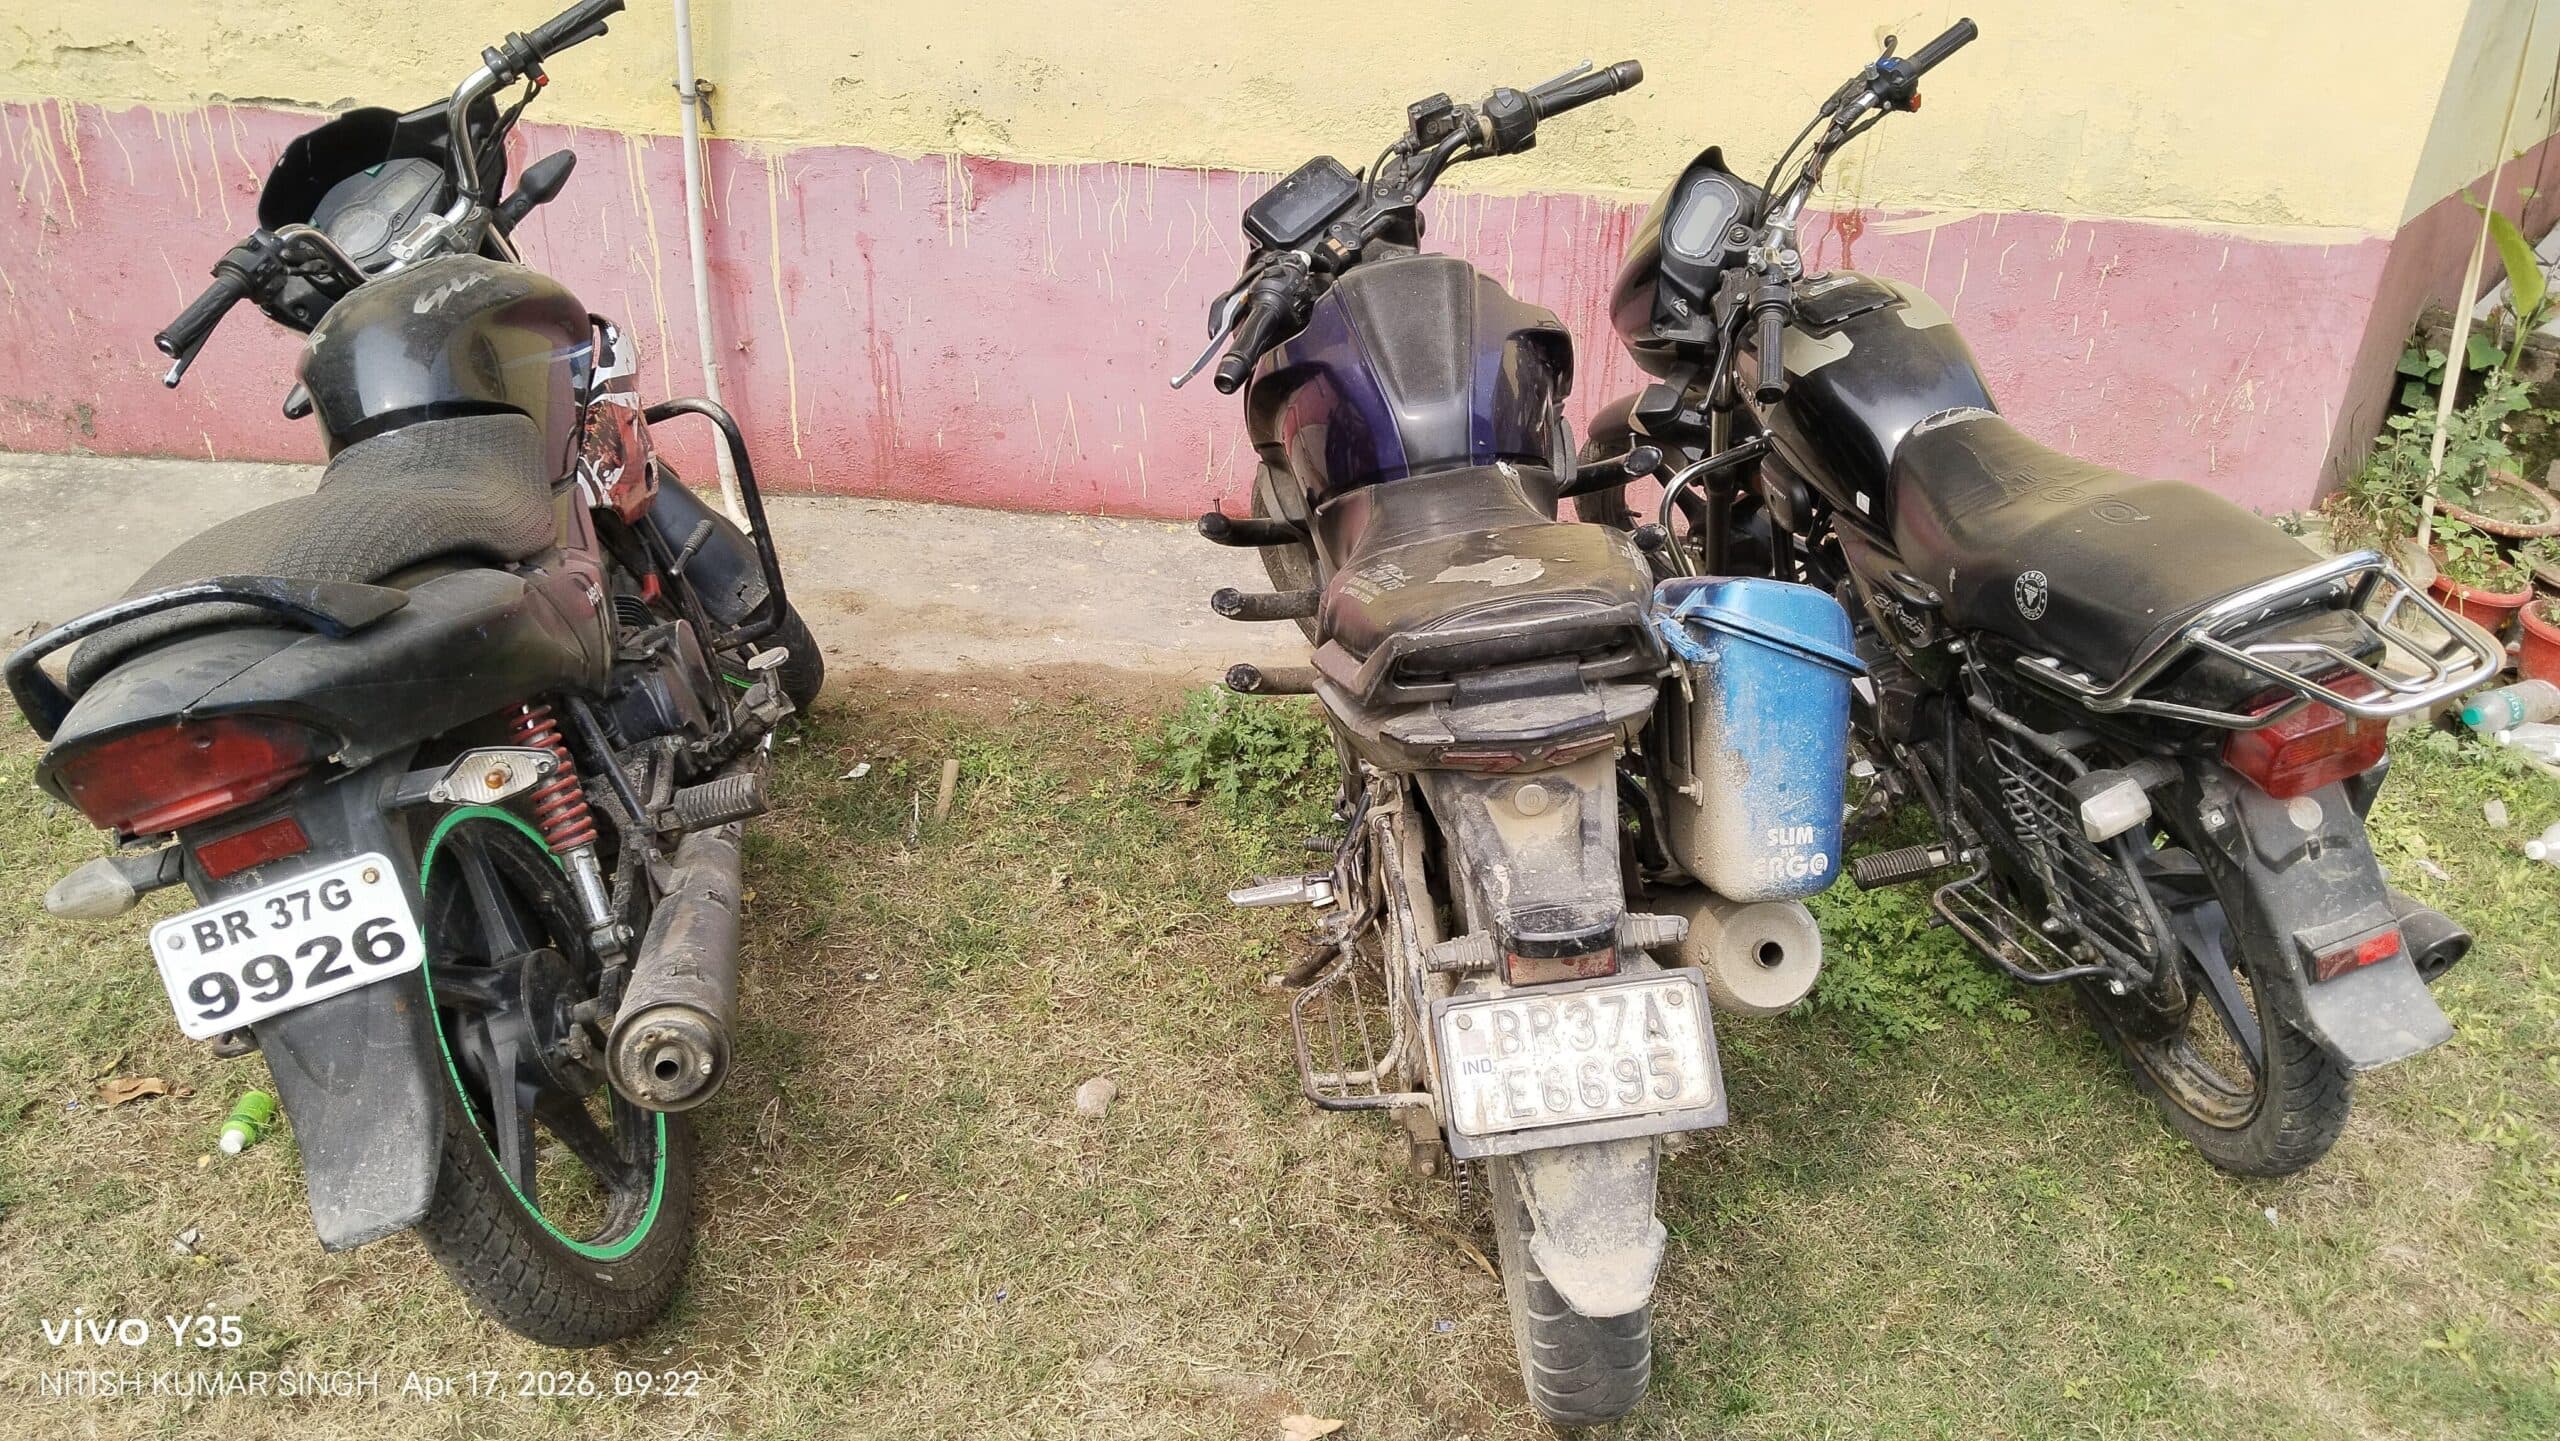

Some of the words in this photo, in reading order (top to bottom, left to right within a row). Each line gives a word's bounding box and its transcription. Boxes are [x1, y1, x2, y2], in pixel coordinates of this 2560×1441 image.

[1767, 826, 1813, 846] SLIM
[192, 910, 257, 954] BR
[265, 879, 352, 930] 37G
[188, 917, 405, 1020] 9926
[1492, 991, 1669, 1059] BR37A
[1462, 1058, 1493, 1076] IND
[1502, 1047, 1680, 1118] E6695
